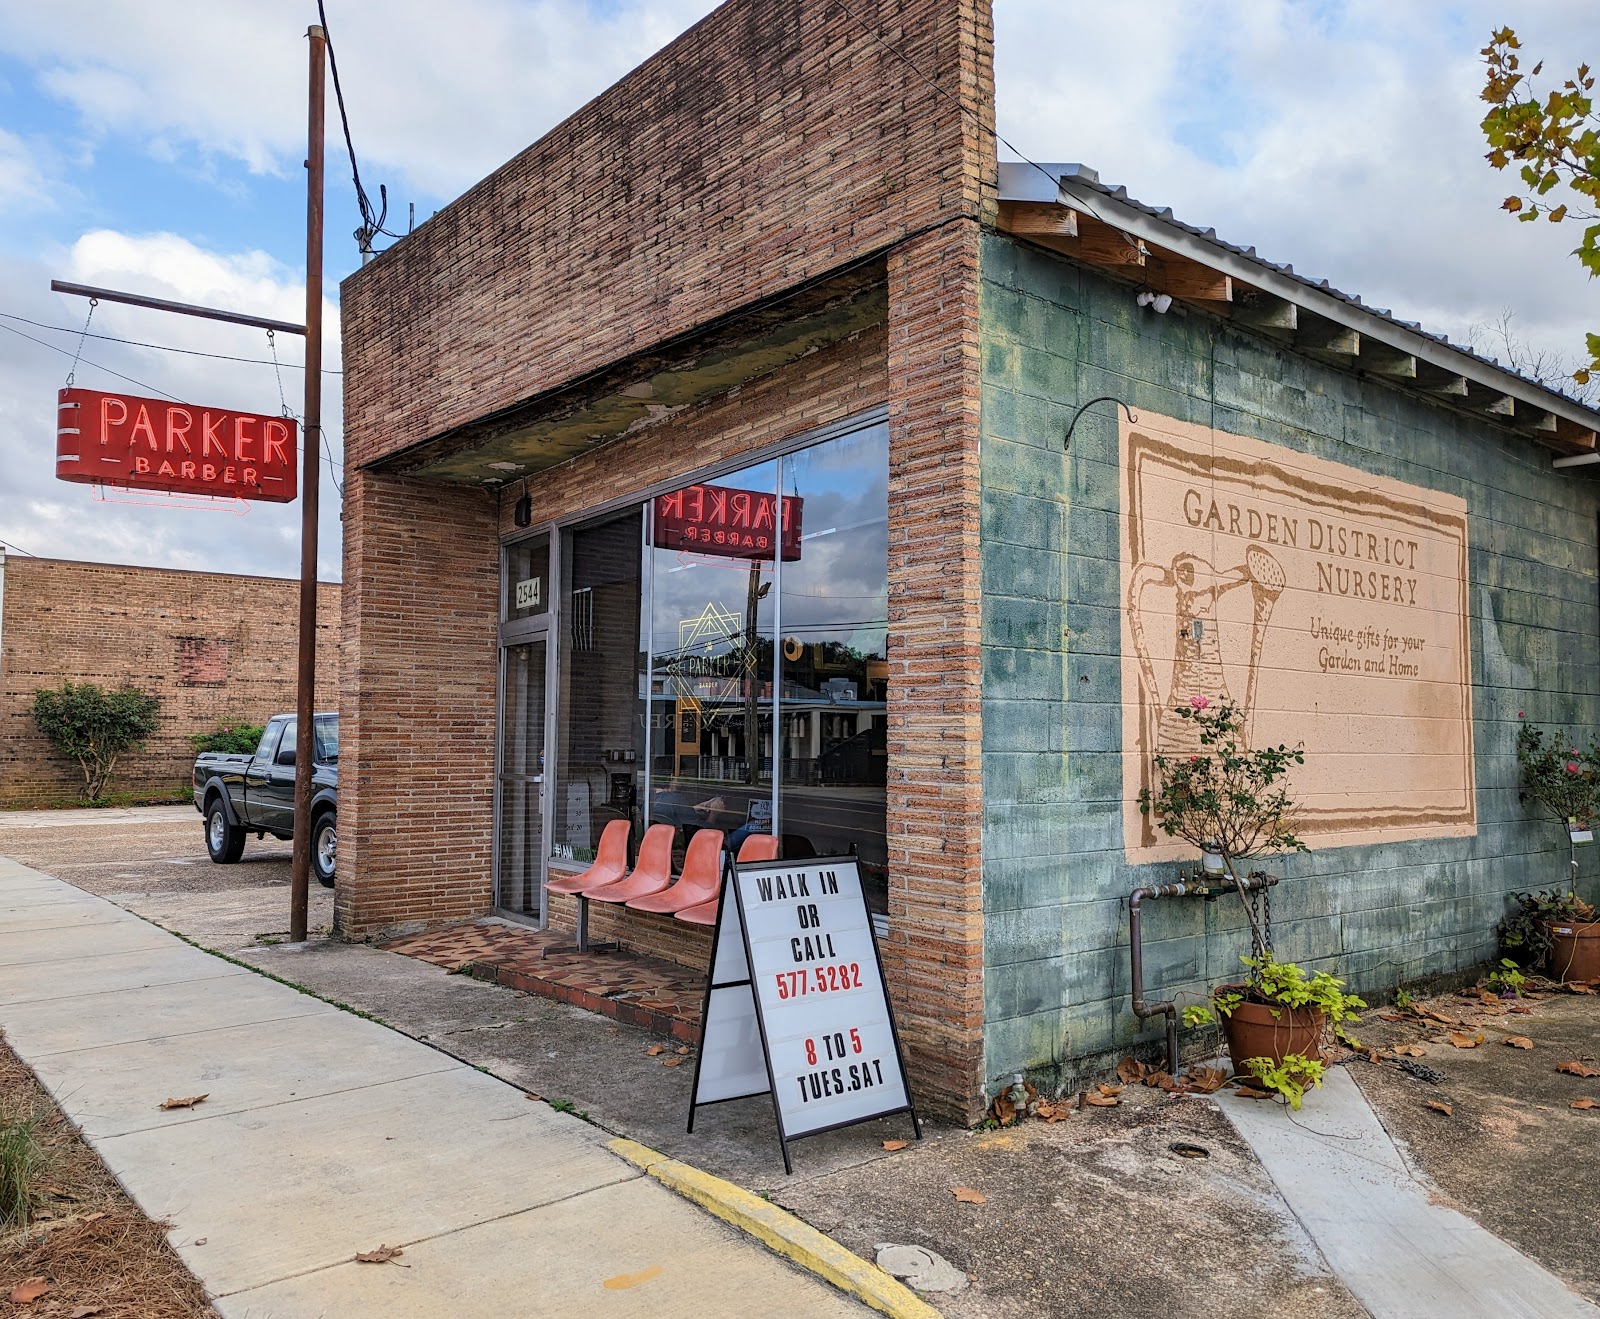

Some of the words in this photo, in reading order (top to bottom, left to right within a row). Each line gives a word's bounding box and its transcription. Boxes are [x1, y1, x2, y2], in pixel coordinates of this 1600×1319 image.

[100, 397, 288, 467] PARKER
[135, 456, 257, 485] BARBER
[1183, 488, 1298, 547] GARDEN
[1307, 518, 1418, 570] DISTRICT
[518, 581, 539, 604] 2544
[1316, 561, 1417, 604] NURSERY
[1310, 616, 1354, 646] Unique
[1356, 624, 1380, 650] gifts
[1382, 627, 1399, 651] for
[1401, 636, 1426, 654] your
[689, 654, 730, 678] PARKER
[1318, 646, 1361, 673] Garden
[1364, 654, 1386, 673] and
[1388, 654, 1419, 677] Home
[756, 873, 811, 902] WALK
[819, 871, 839, 895] IN
[797, 904, 820, 929] OR
[790, 933, 836, 963] CALL
[775, 962, 863, 1000] 577.5282
[804, 1038, 818, 1066] 8
[822, 1032, 847, 1061] TO
[849, 1027, 863, 1054] 5
[797, 1059, 884, 1103] TUES.SAT
